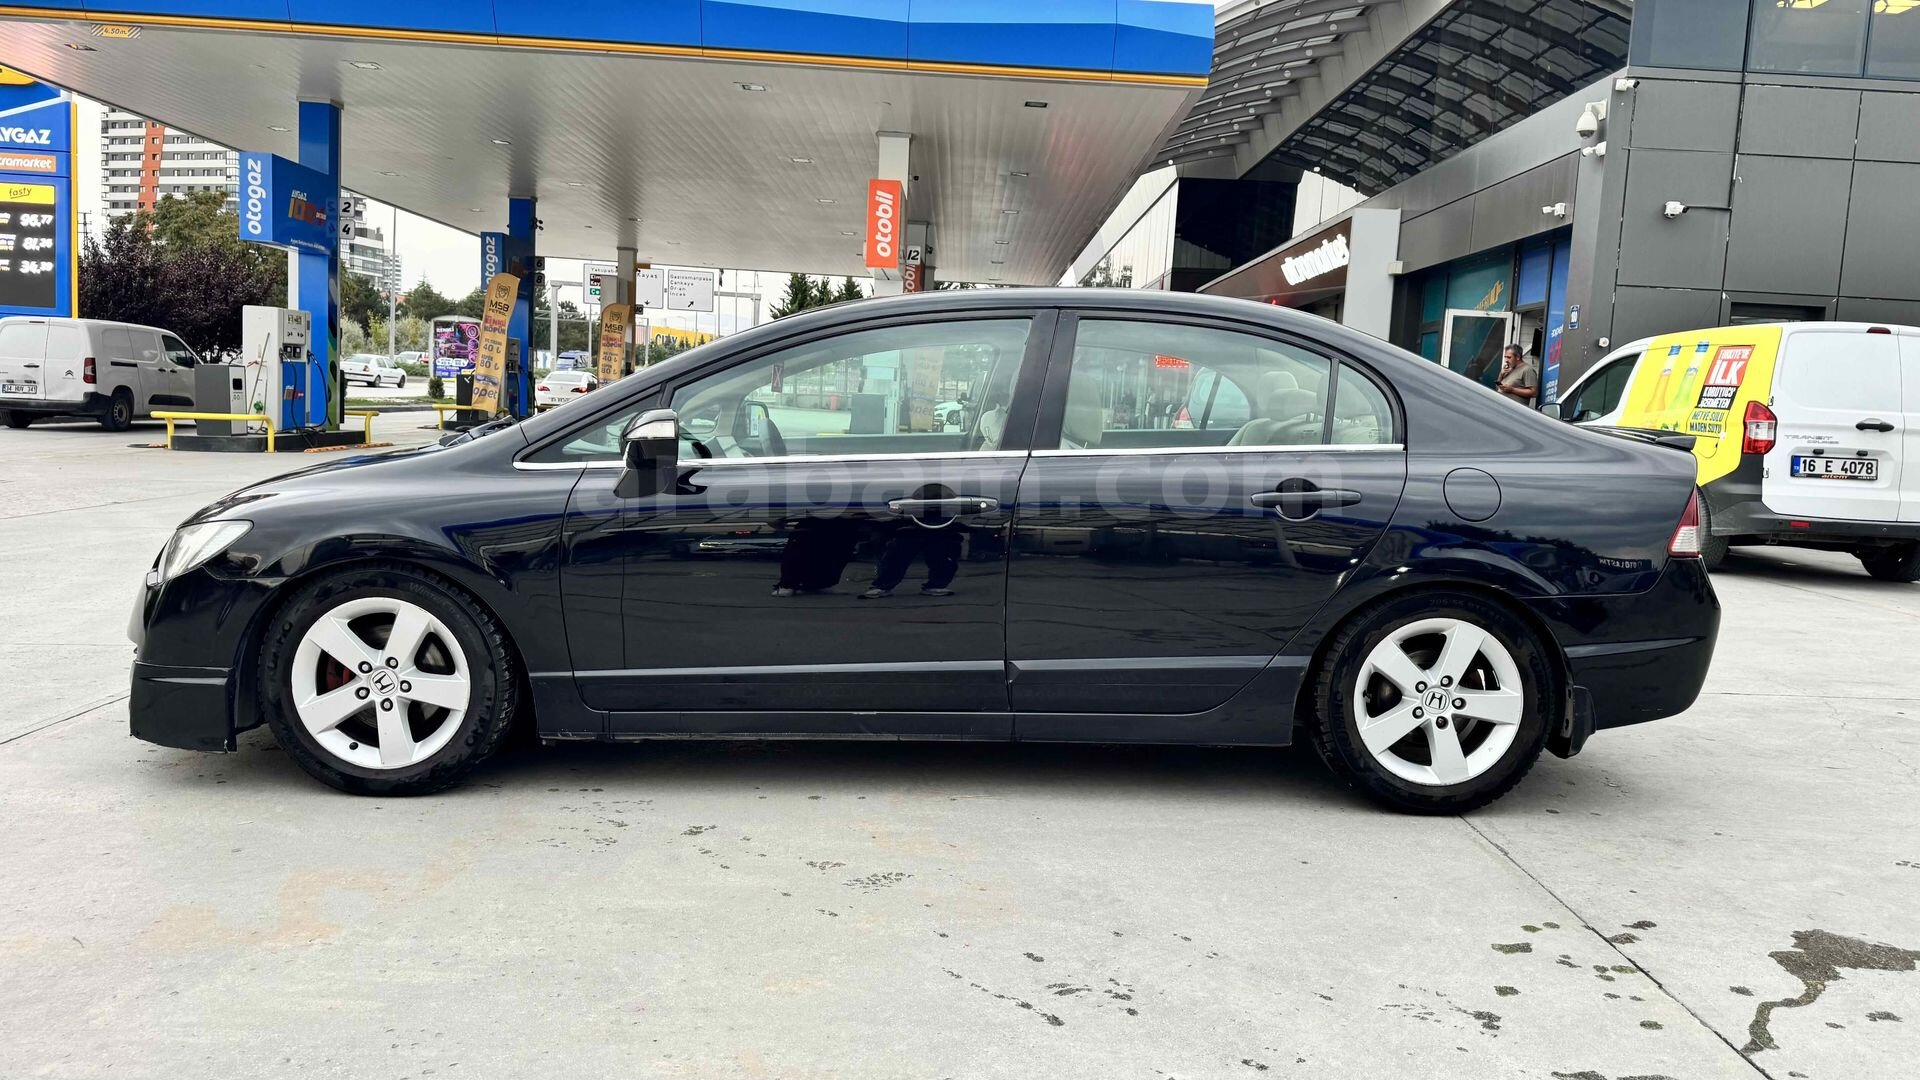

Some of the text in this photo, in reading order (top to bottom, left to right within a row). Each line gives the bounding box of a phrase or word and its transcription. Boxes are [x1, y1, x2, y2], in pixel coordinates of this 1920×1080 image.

[246, 158, 266, 235] otogaz
[342, 202, 351, 212] 2
[342, 224, 351, 234] 4
[875, 190, 894, 257] otobil
[908, 250, 920, 260] 12
[1802, 459, 1816, 472] 16
[1825, 460, 1833, 473] E
[1841, 461, 1873, 475] 4078
